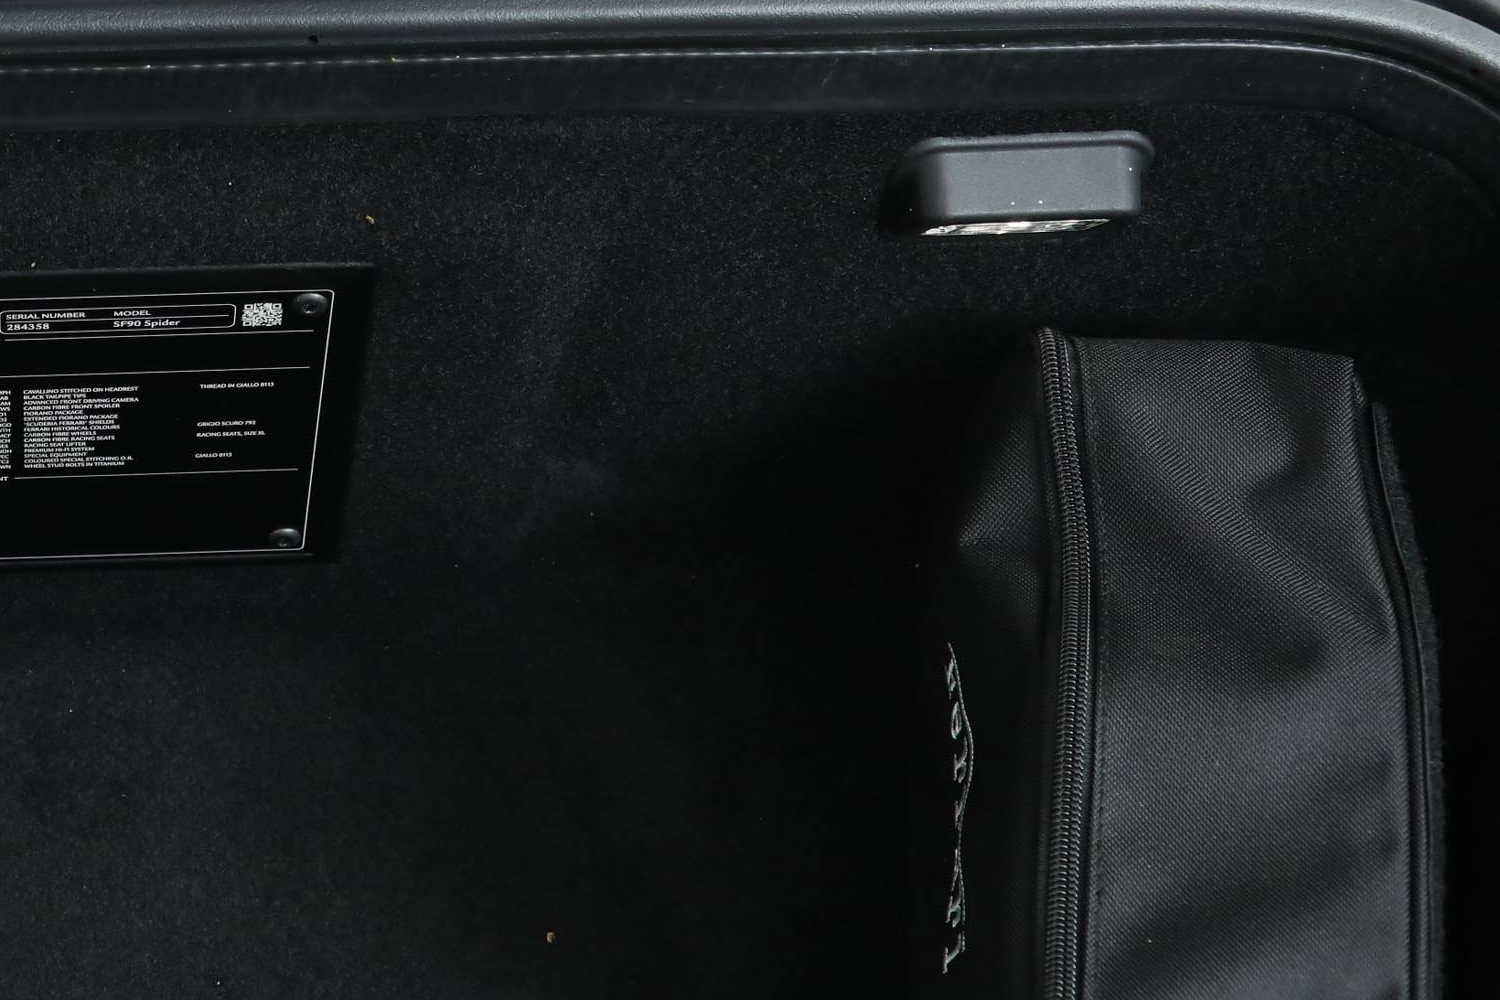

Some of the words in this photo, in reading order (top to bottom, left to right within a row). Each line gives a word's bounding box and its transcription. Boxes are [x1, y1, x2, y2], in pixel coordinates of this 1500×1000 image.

[6, 323, 50, 331] 284358
[113, 320, 141, 328] SF90
[144, 319, 181, 329] Spider
